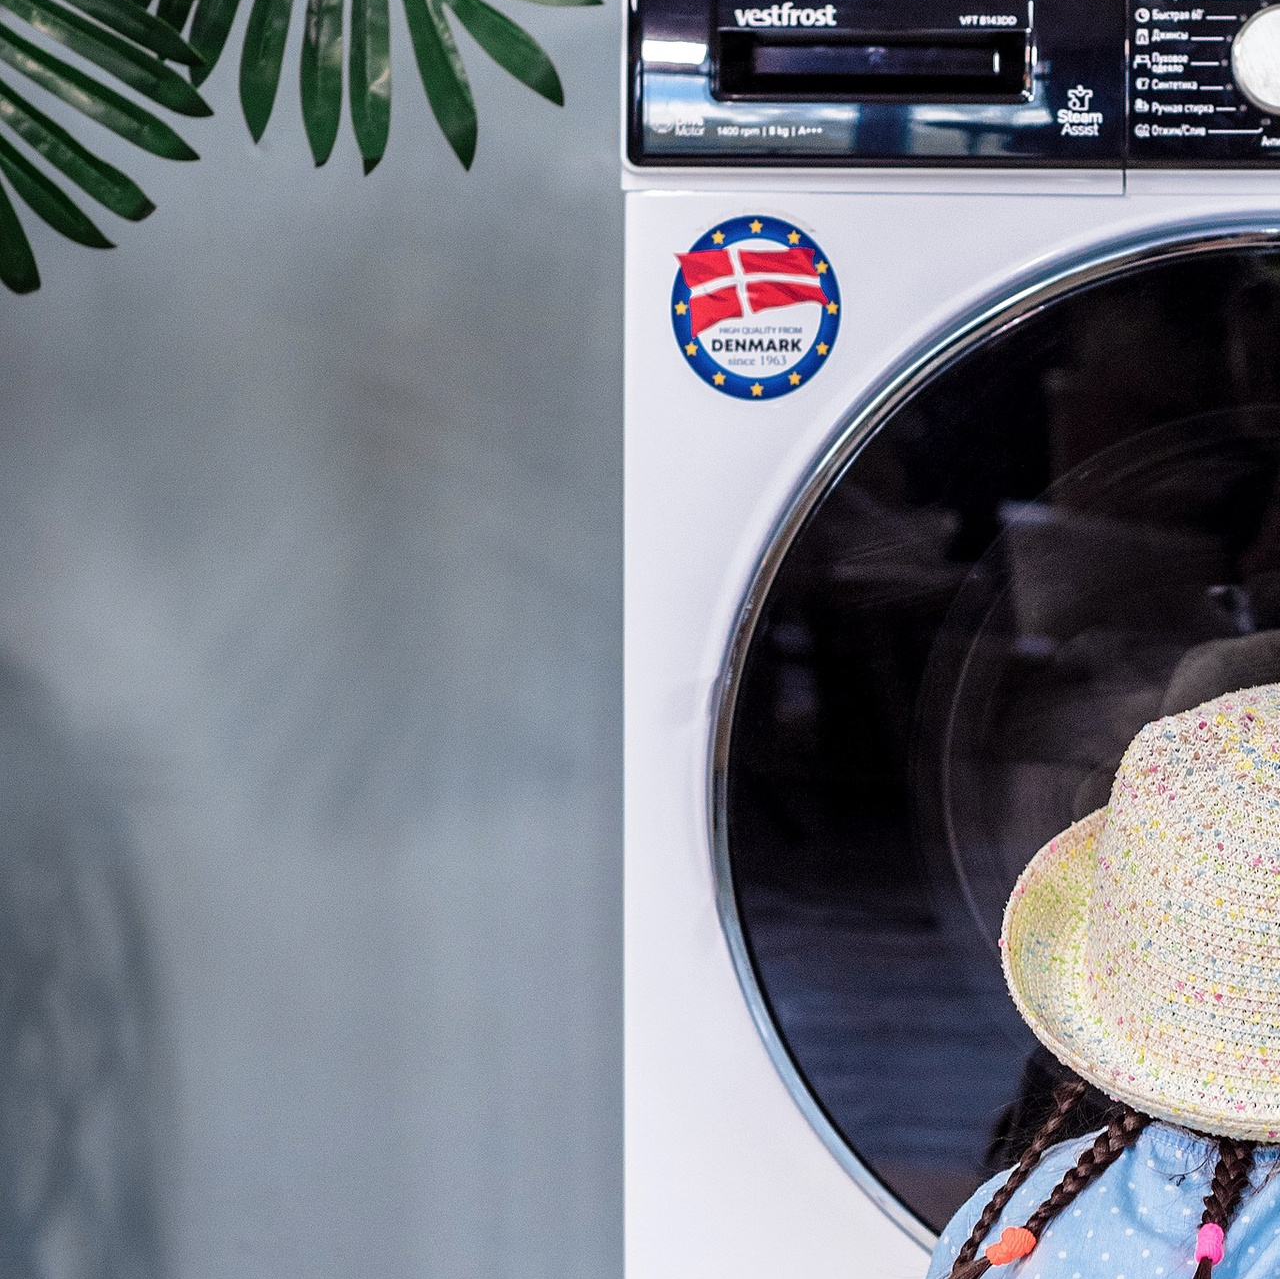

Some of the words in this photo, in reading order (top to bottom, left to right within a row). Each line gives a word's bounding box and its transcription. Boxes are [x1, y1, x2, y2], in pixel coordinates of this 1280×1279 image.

[734, 1, 837, 27] vestfrost
[1151, 101, 1183, 116] Ручная
[1057, 109, 1103, 124] Steam
[717, 126, 740, 136] 1400
[1060, 123, 1099, 136] Assist
[719, 326, 740, 335] HIGH
[741, 326, 777, 335] QUALITY
[778, 326, 803, 335] FROM
[711, 338, 803, 352] DENMARK
[728, 355, 756, 366] since
[760, 355, 787, 366] 1963
